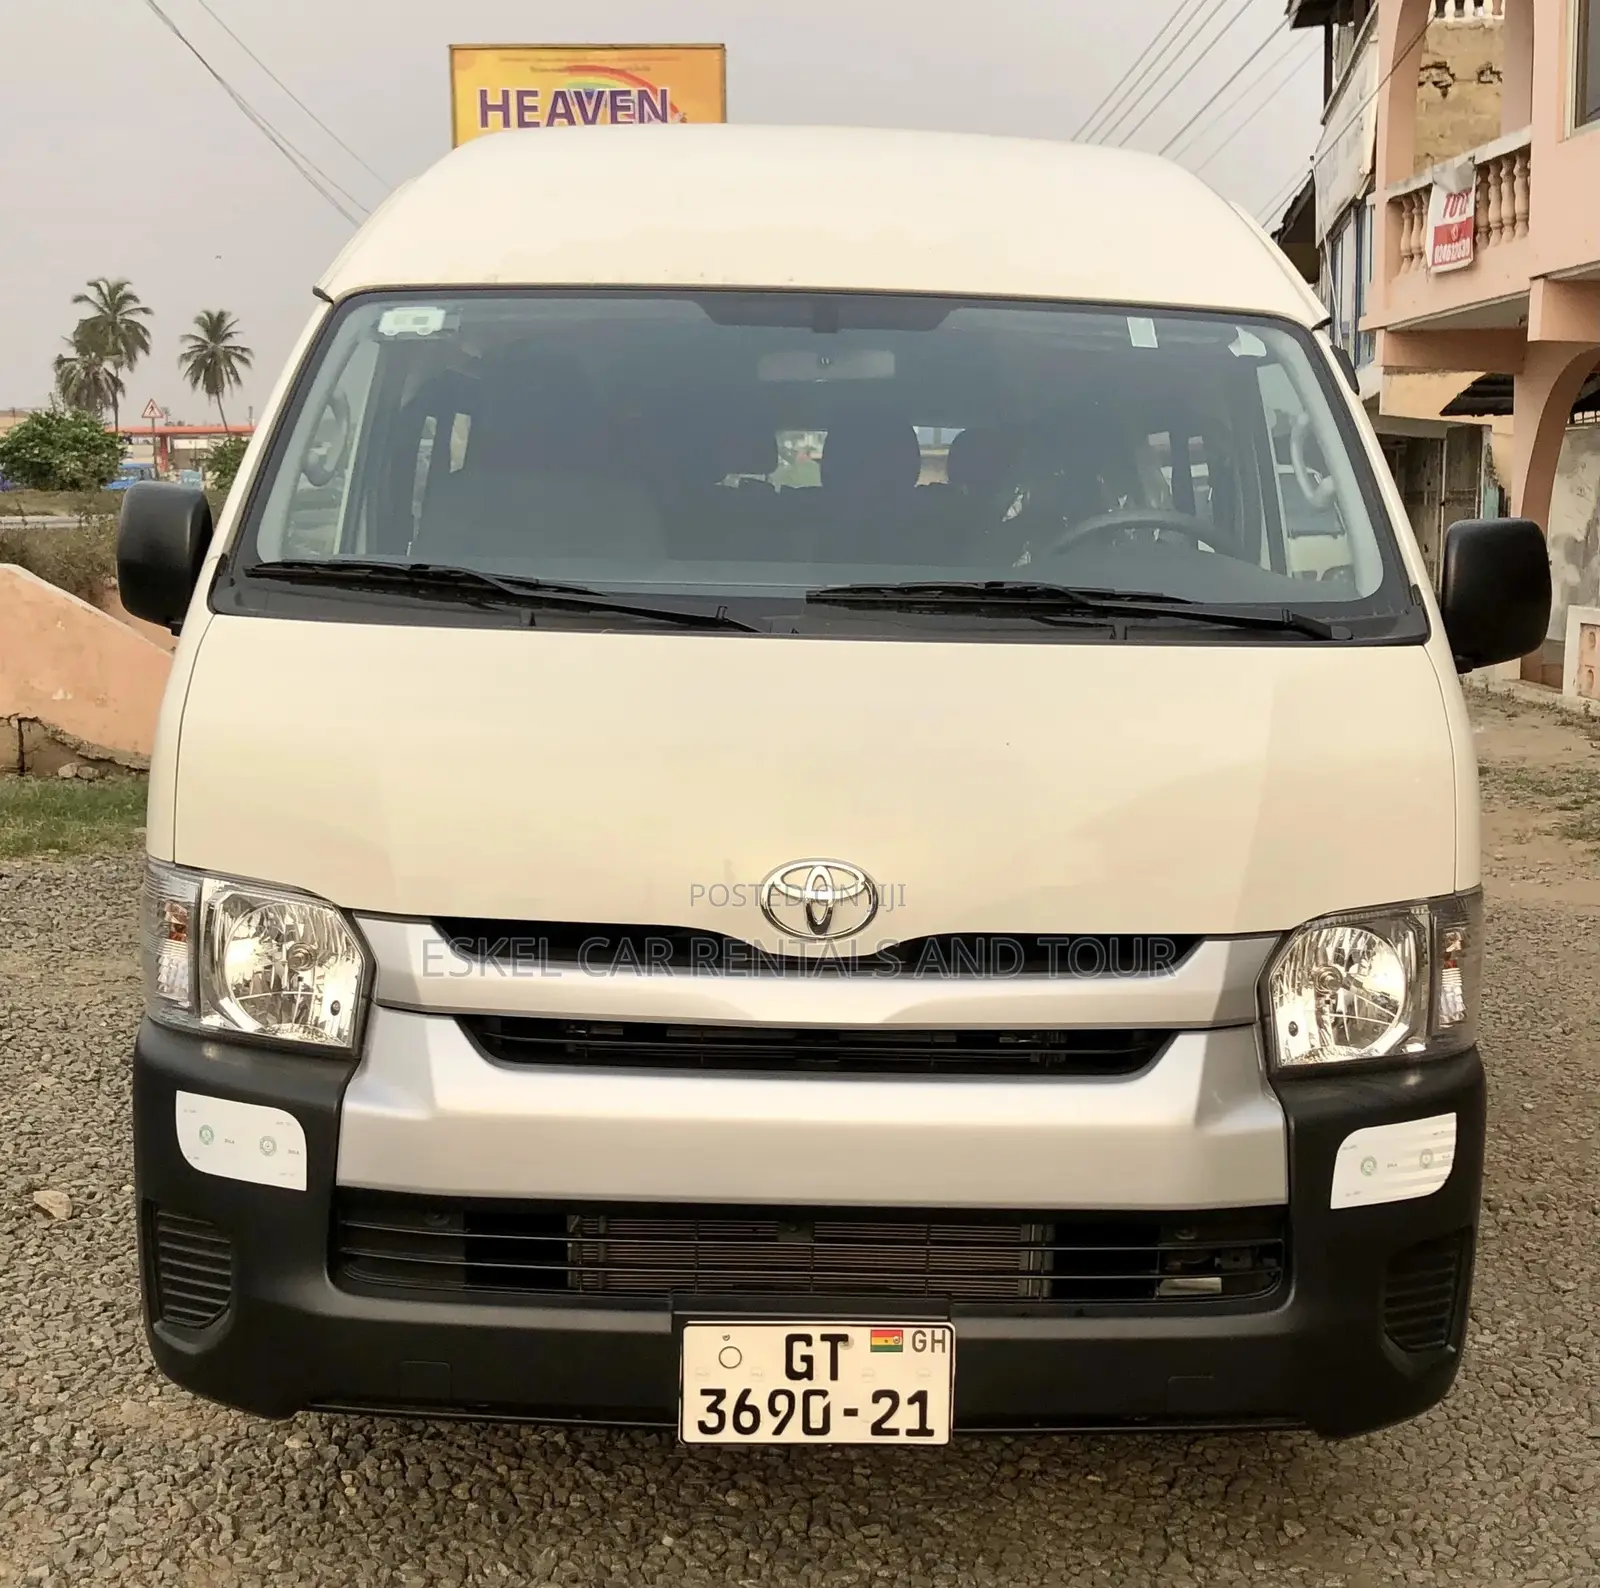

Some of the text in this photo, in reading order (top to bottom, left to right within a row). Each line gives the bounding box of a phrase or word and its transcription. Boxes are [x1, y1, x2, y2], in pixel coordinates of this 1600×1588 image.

[478, 88, 669, 128] HEAVEN
[785, 1329, 946, 1381] GT GH
[697, 1387, 935, 1437] 3690-21
